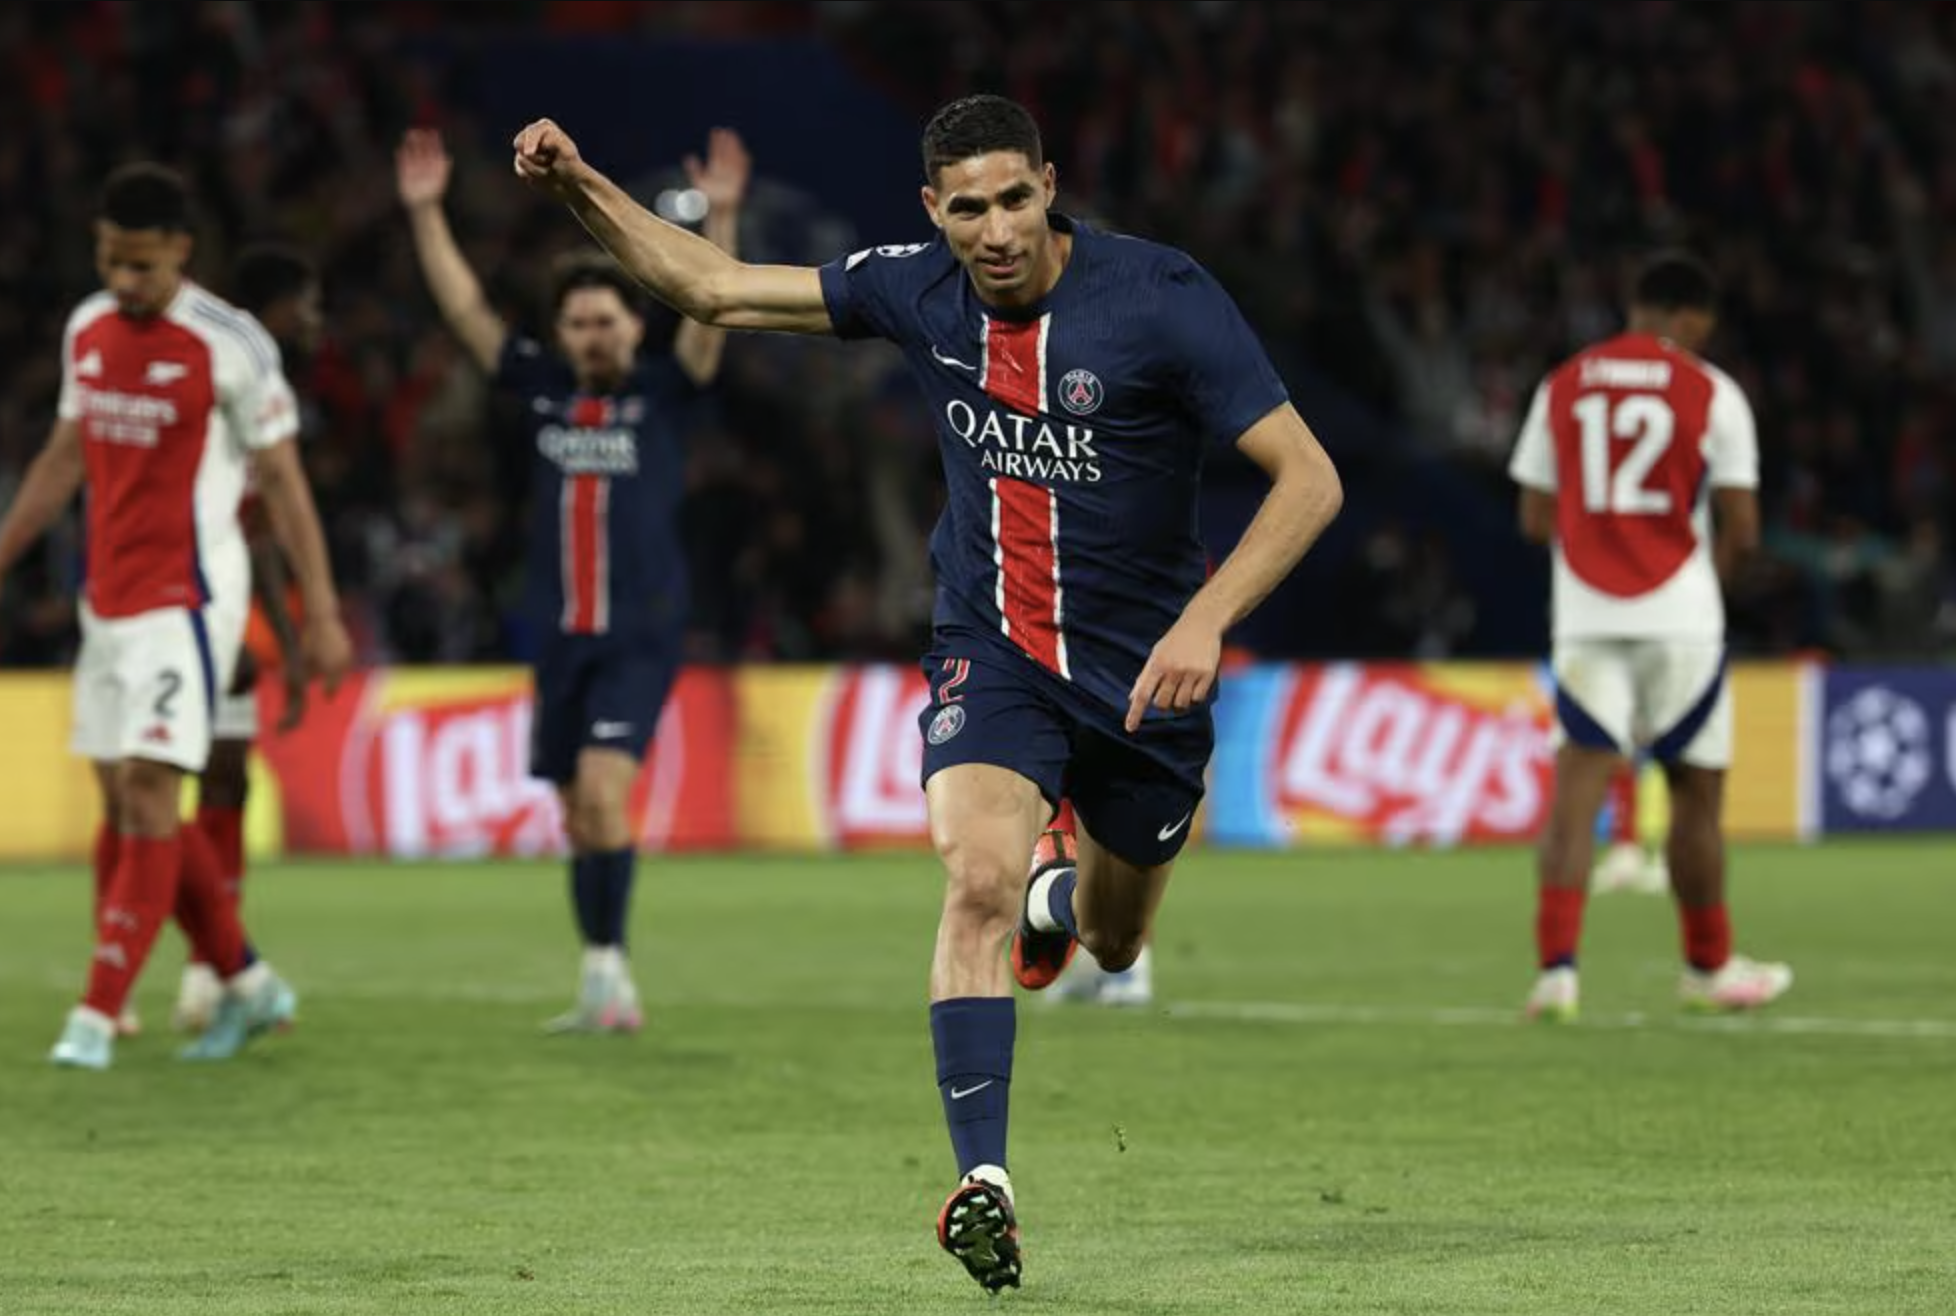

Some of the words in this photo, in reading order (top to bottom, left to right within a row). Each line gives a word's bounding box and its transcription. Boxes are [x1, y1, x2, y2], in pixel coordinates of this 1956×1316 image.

[947, 399, 1097, 458] QATAR
[1572, 392, 1675, 514] 12
[981, 449, 1101, 482] AIRWAYS
[153, 668, 183, 718] 2
[938, 658, 971, 705] 2
